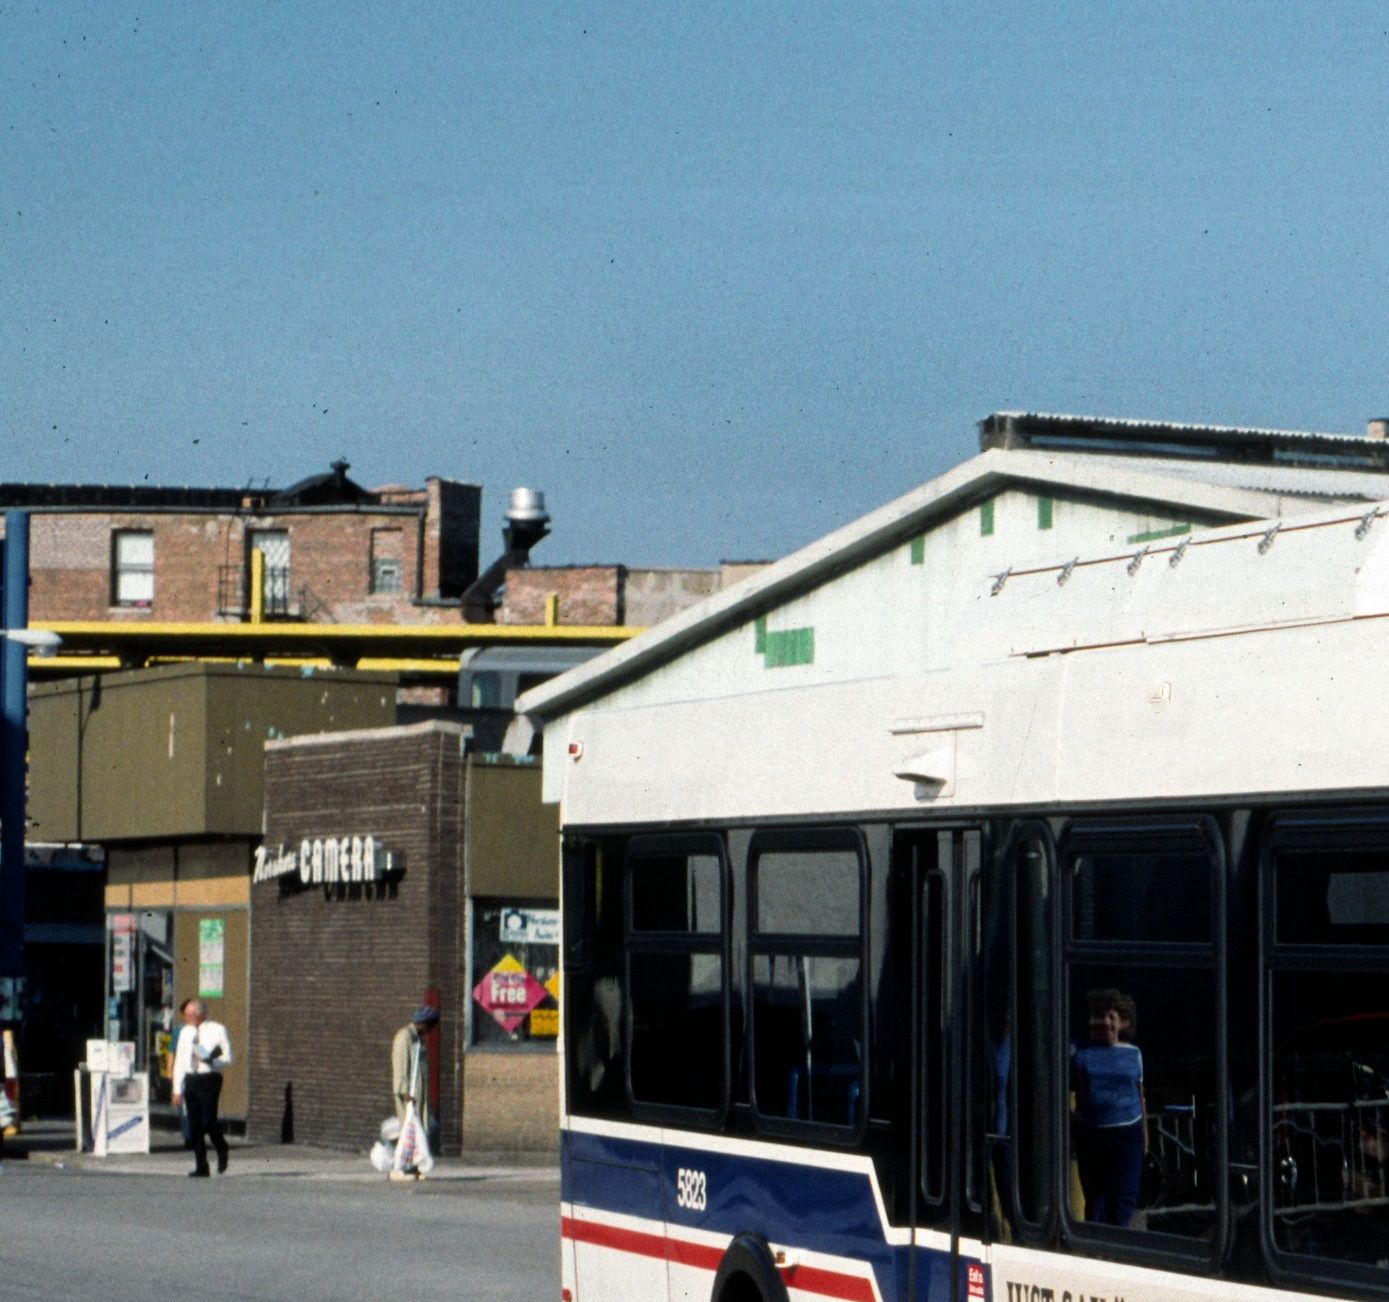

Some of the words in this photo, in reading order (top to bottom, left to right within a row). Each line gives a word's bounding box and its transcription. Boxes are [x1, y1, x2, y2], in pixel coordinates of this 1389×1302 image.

[301, 835, 374, 883] CAMERA
[490, 982, 527, 1004] Free
[677, 1168, 707, 1212] 5823
